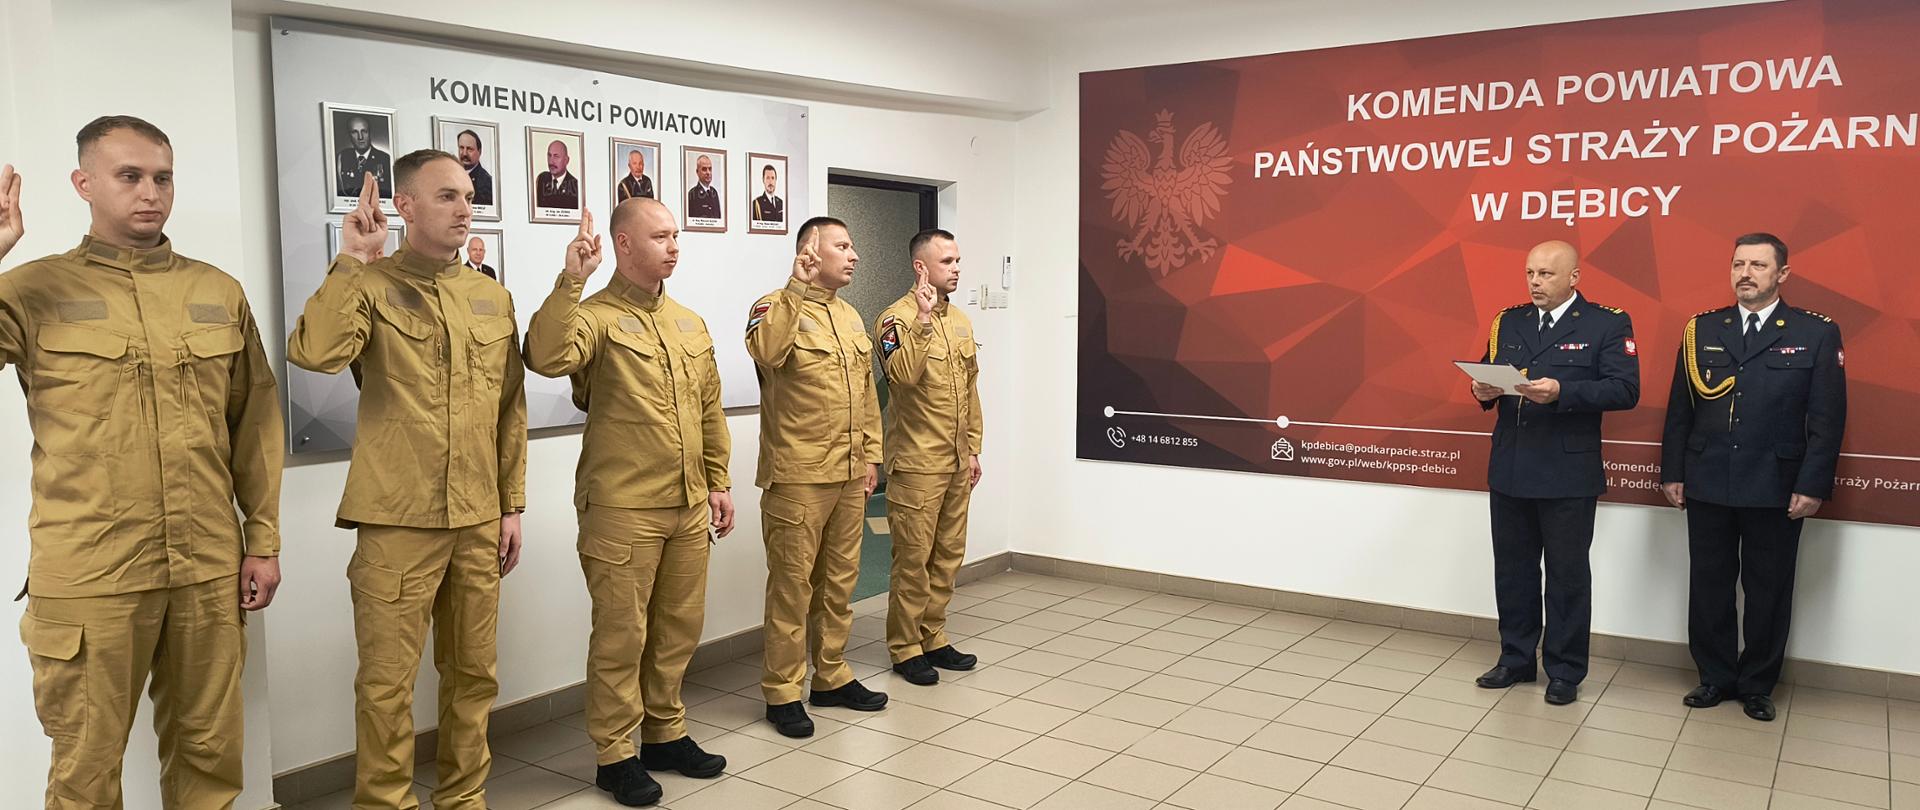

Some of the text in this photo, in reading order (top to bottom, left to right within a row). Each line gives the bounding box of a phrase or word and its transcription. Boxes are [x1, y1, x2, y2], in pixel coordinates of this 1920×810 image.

[1347, 55, 1843, 122] KOMENDA POWIATOWA
[430, 77, 726, 139] KOMENDANCI POWIATOWI
[1254, 111, 1919, 178] PAŃSTWOWEJ STRAŻY POŻARN
[1471, 185, 1682, 226] W DĘBICY
[1131, 434, 1198, 447] +48 14 6812 855
[1301, 440, 1461, 461] kpdebica@podkarpacie.straz.pl
[1301, 455, 1457, 475] www.gov.pl/web/kppsp-debica
[1602, 460, 1661, 474] Komenda
[1834, 476, 1870, 490] traży
